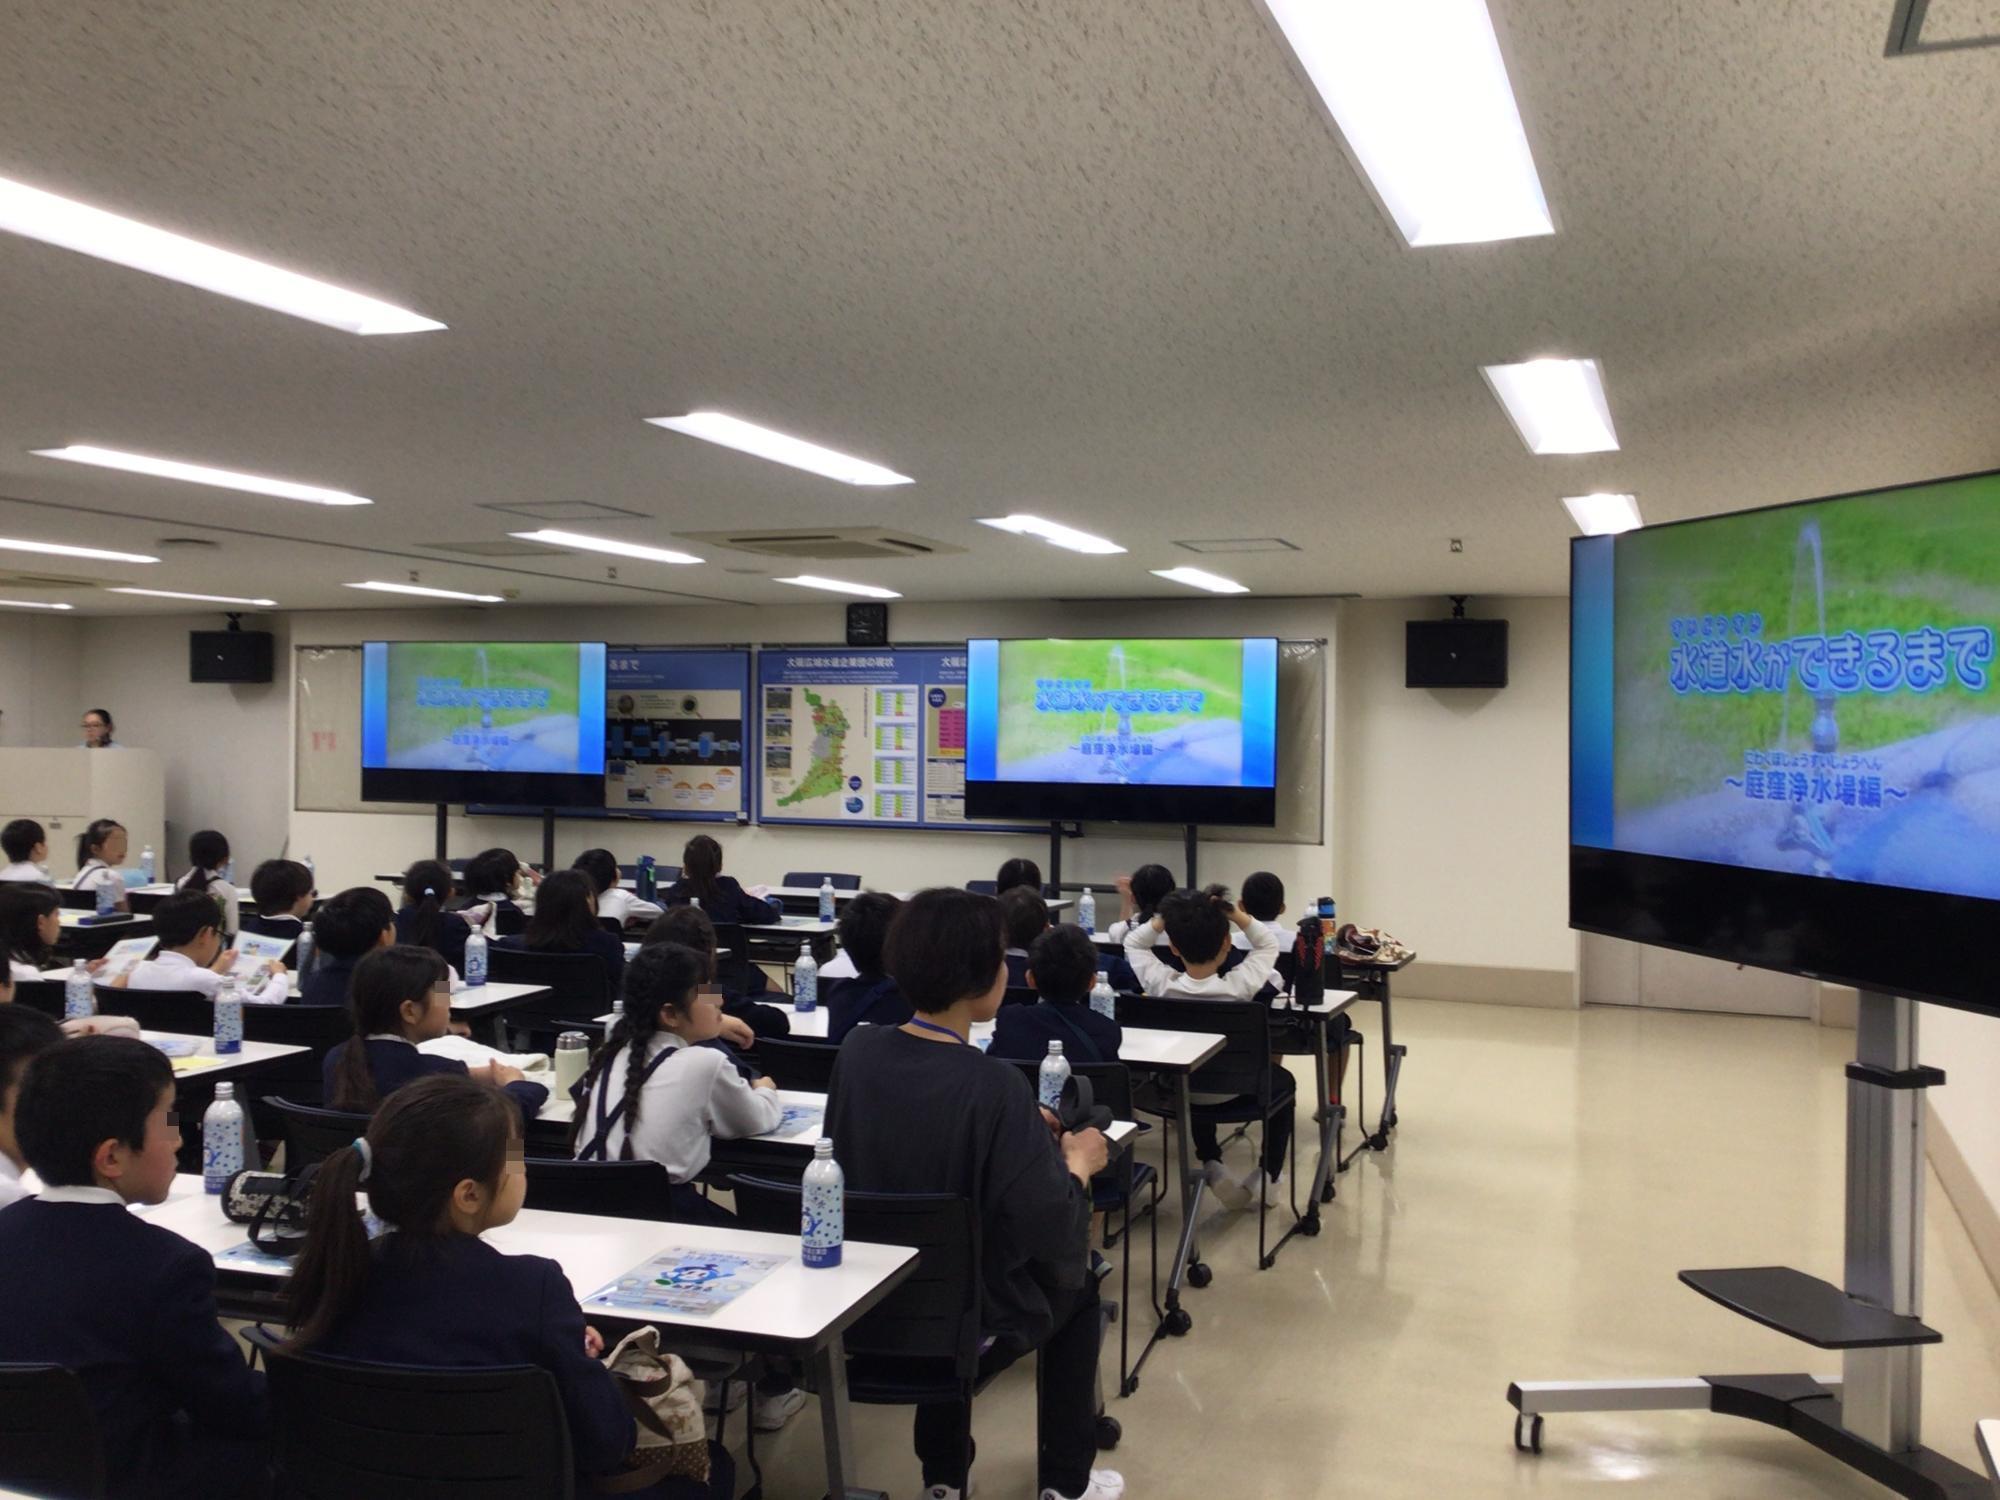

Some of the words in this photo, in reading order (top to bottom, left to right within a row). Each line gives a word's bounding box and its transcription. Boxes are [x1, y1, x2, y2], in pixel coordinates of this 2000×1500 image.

[1671, 626, 1992, 692] 水道水ができるまで
